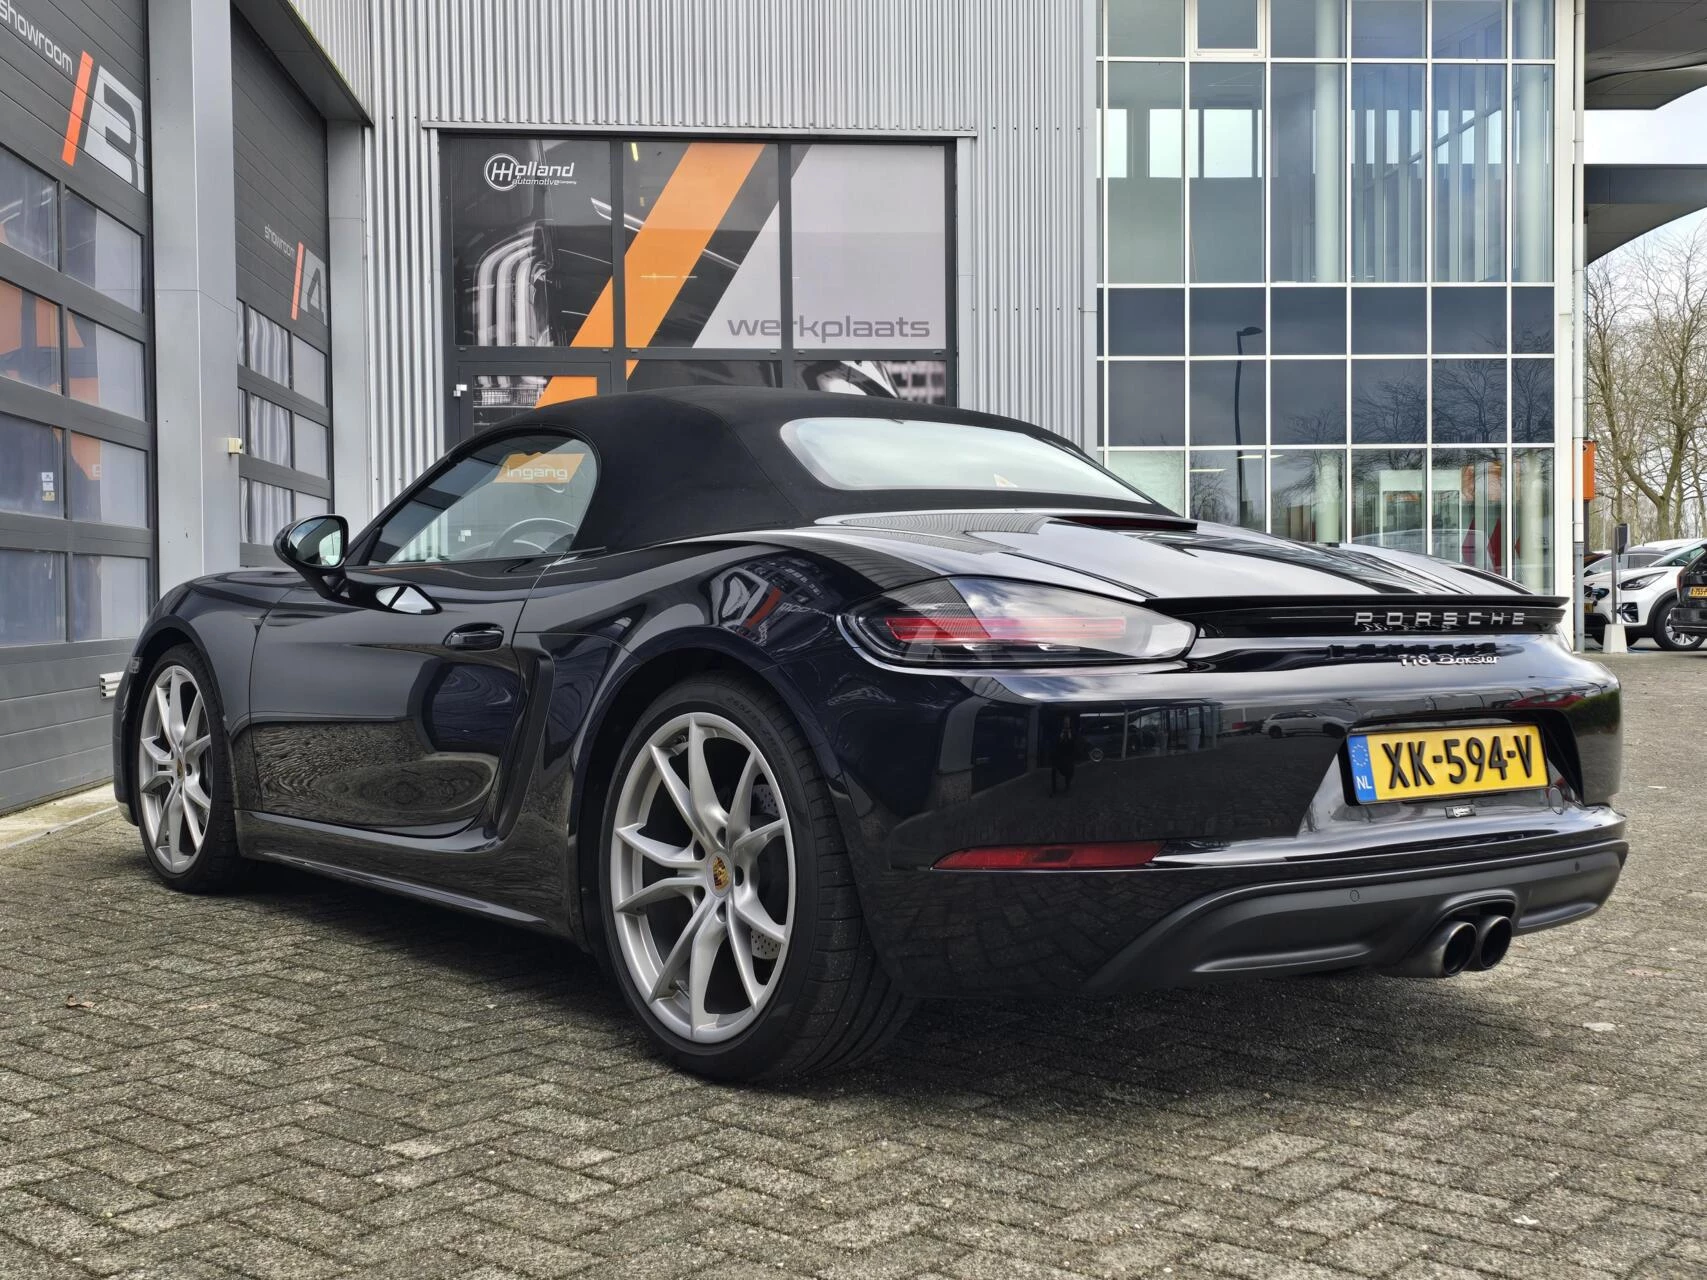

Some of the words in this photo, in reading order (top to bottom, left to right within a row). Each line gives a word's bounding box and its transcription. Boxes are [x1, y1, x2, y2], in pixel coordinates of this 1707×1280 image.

[0, 0, 73, 76] showroom
[727, 315, 930, 343] wekplaats
[1354, 612, 1525, 626] PORSCHE
[1381, 734, 1532, 790] XK-594-V
[1355, 775, 1373, 790] NL
